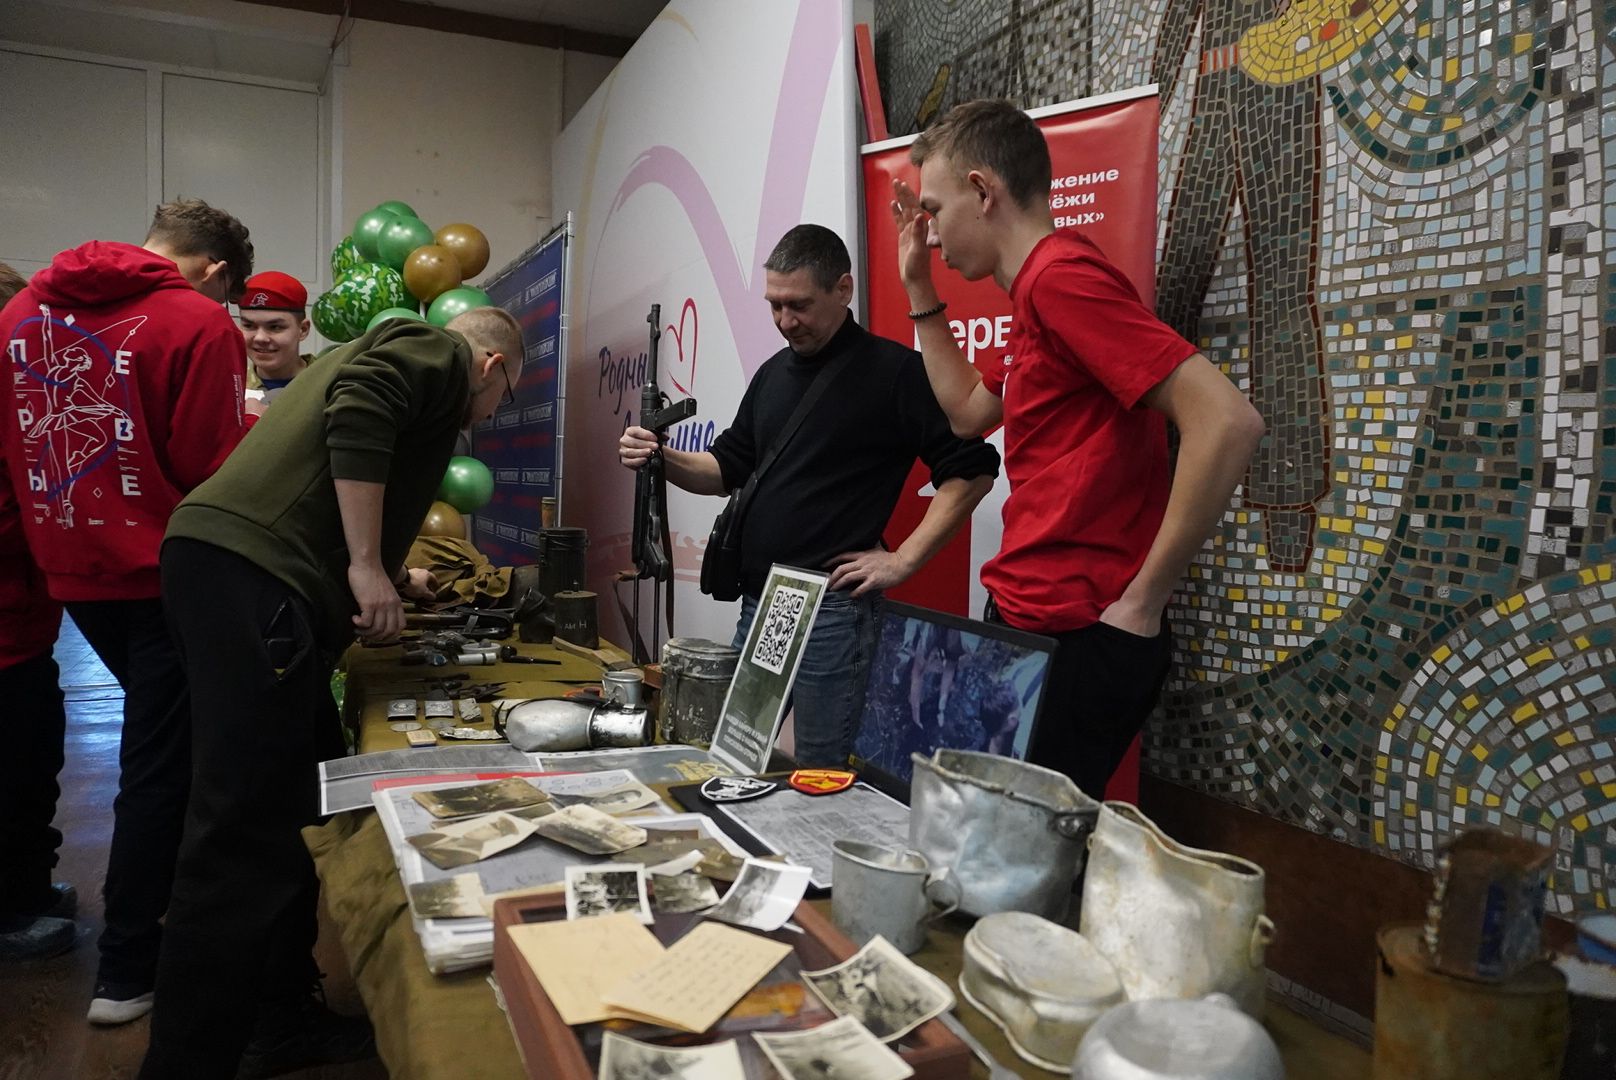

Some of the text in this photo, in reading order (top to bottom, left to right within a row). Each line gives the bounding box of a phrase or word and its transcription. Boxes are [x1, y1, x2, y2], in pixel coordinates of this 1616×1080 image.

[1050, 169, 1119, 190] жение
[1049, 193, 1095, 211] ёжи
[1053, 212, 1105, 229] вых»
